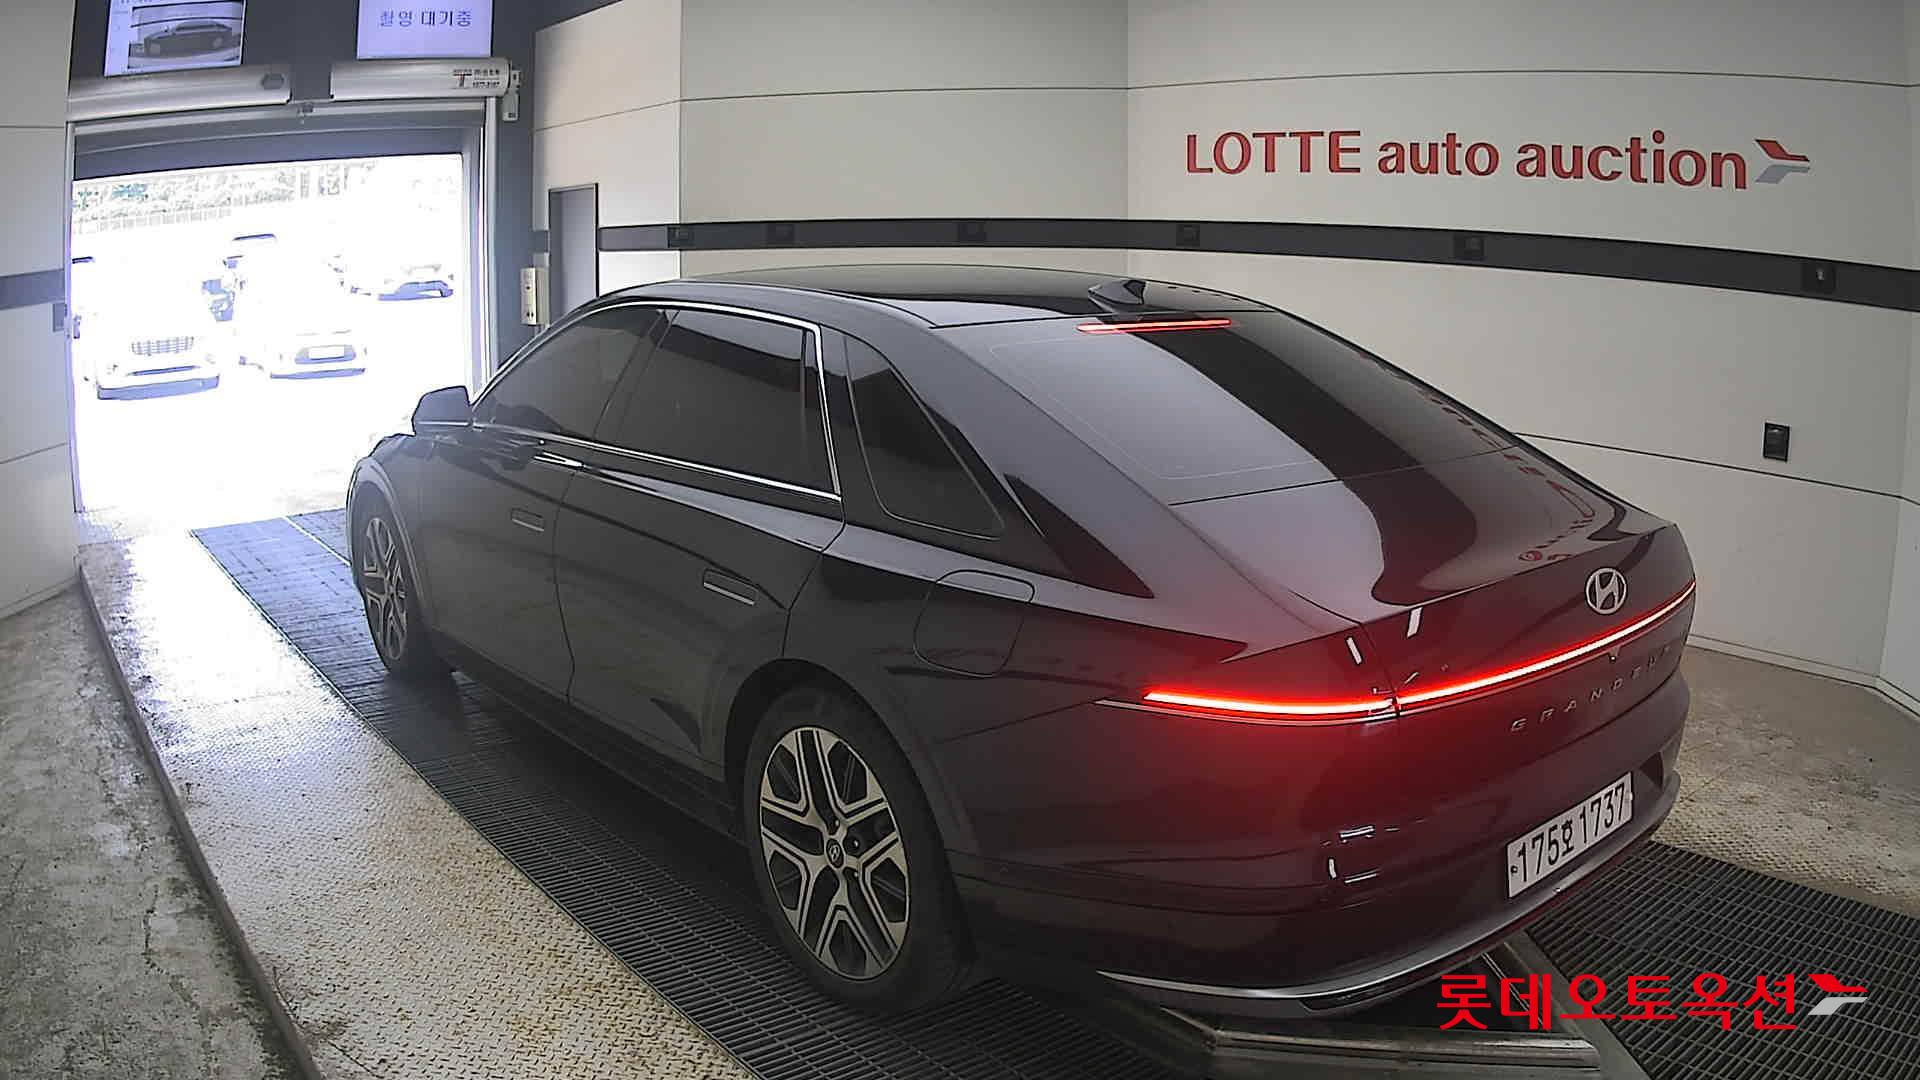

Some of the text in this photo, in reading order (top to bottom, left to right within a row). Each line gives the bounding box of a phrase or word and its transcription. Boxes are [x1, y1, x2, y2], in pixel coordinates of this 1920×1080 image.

[420, 10, 473, 28] 대기중
[1186, 130, 1747, 190] LOTTE auto auction
[1517, 782, 1626, 883] 175호 1737
